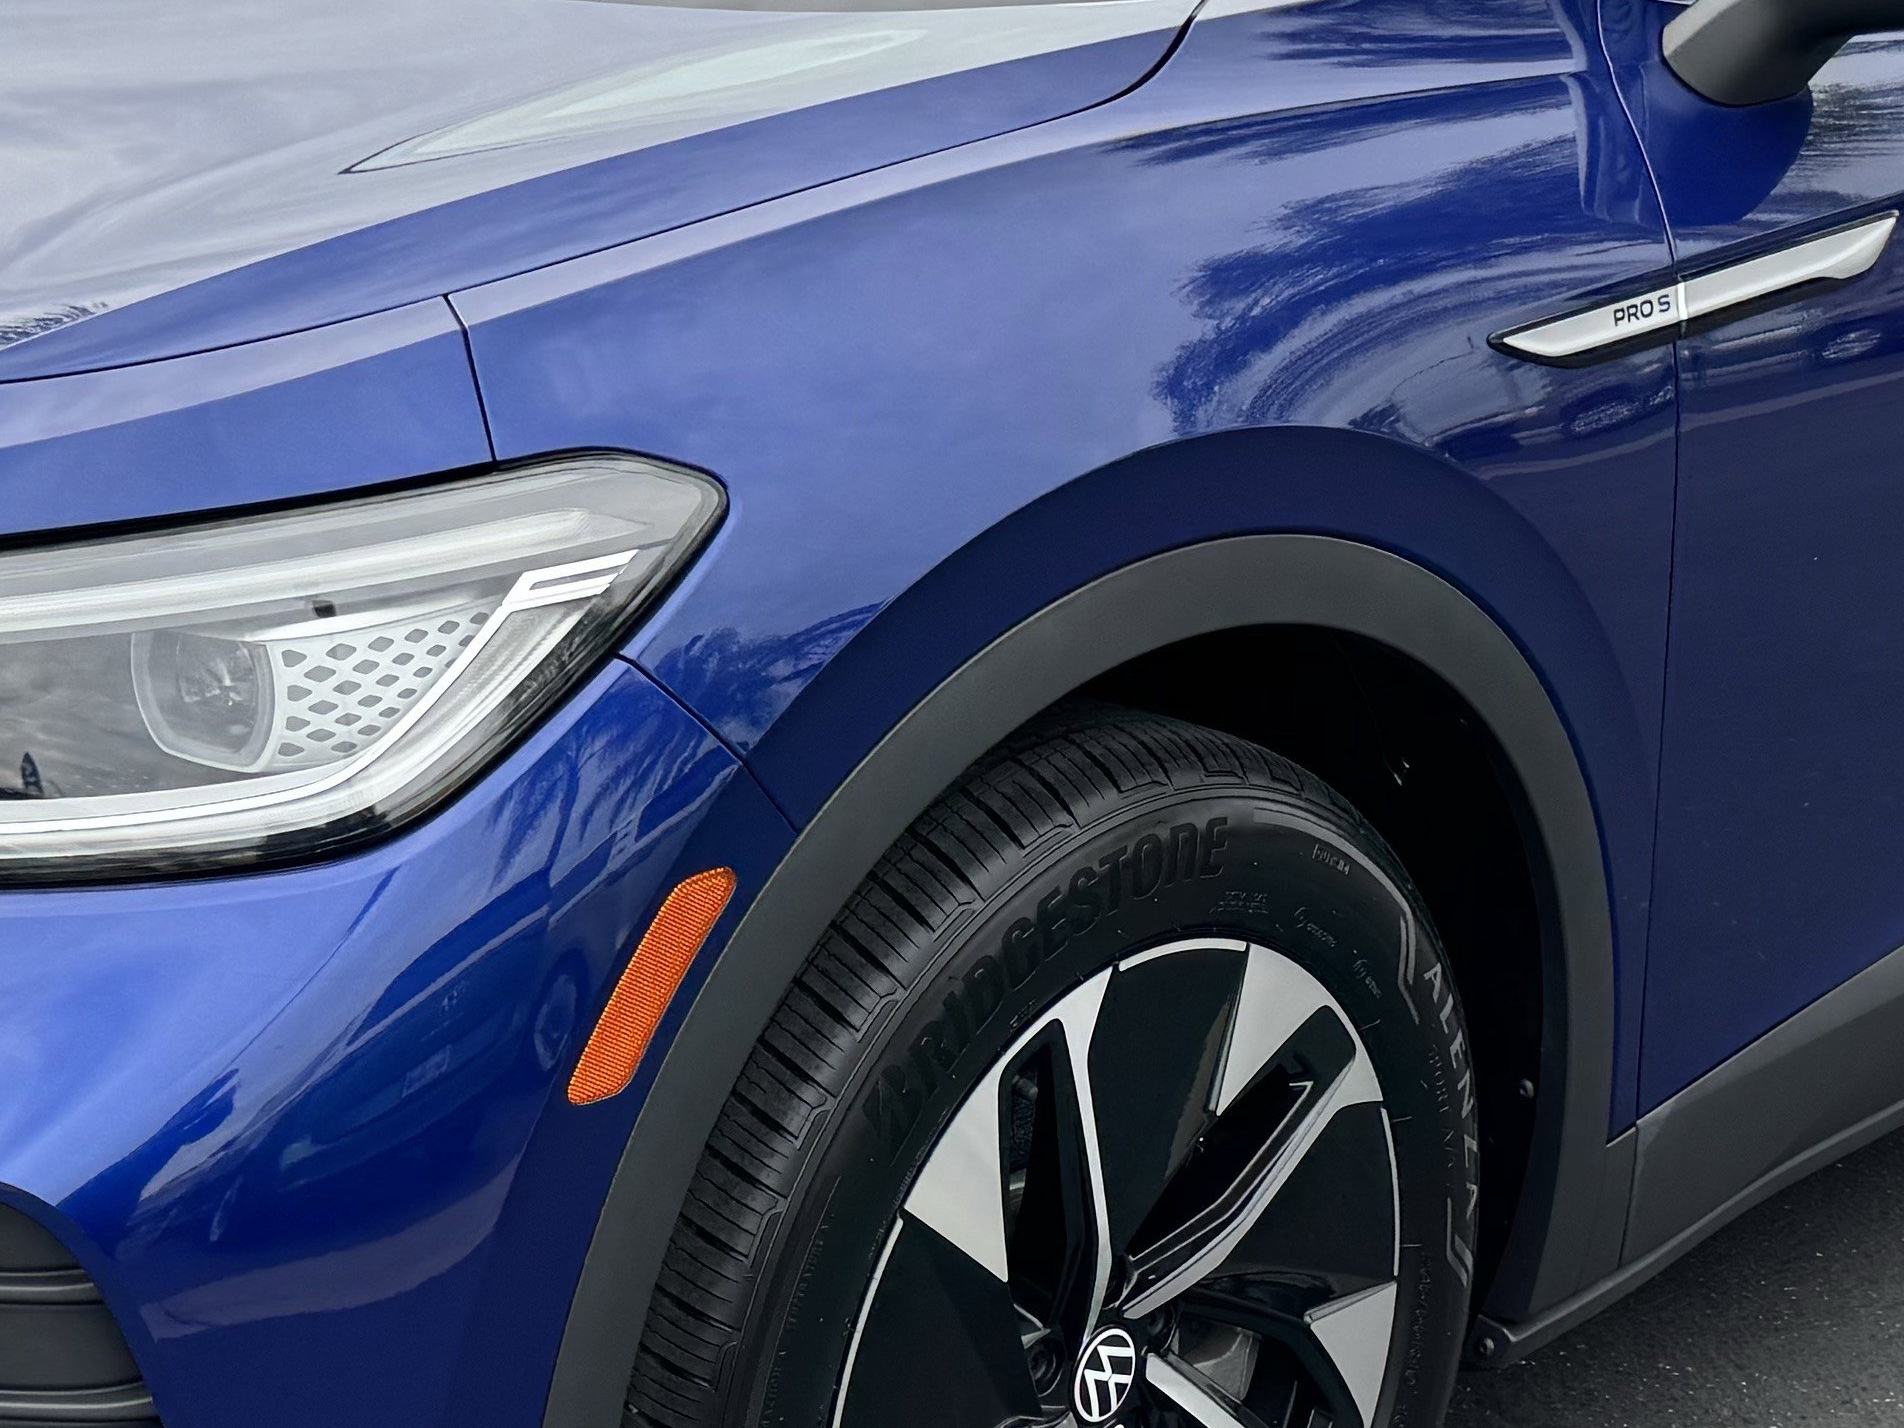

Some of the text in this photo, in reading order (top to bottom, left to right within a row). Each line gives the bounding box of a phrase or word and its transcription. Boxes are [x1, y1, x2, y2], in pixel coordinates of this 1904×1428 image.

[1613, 294, 1671, 327] PRO S
[861, 816, 1229, 1166] BRIDGESTONE
[1423, 962, 1479, 1220] ALENZA
